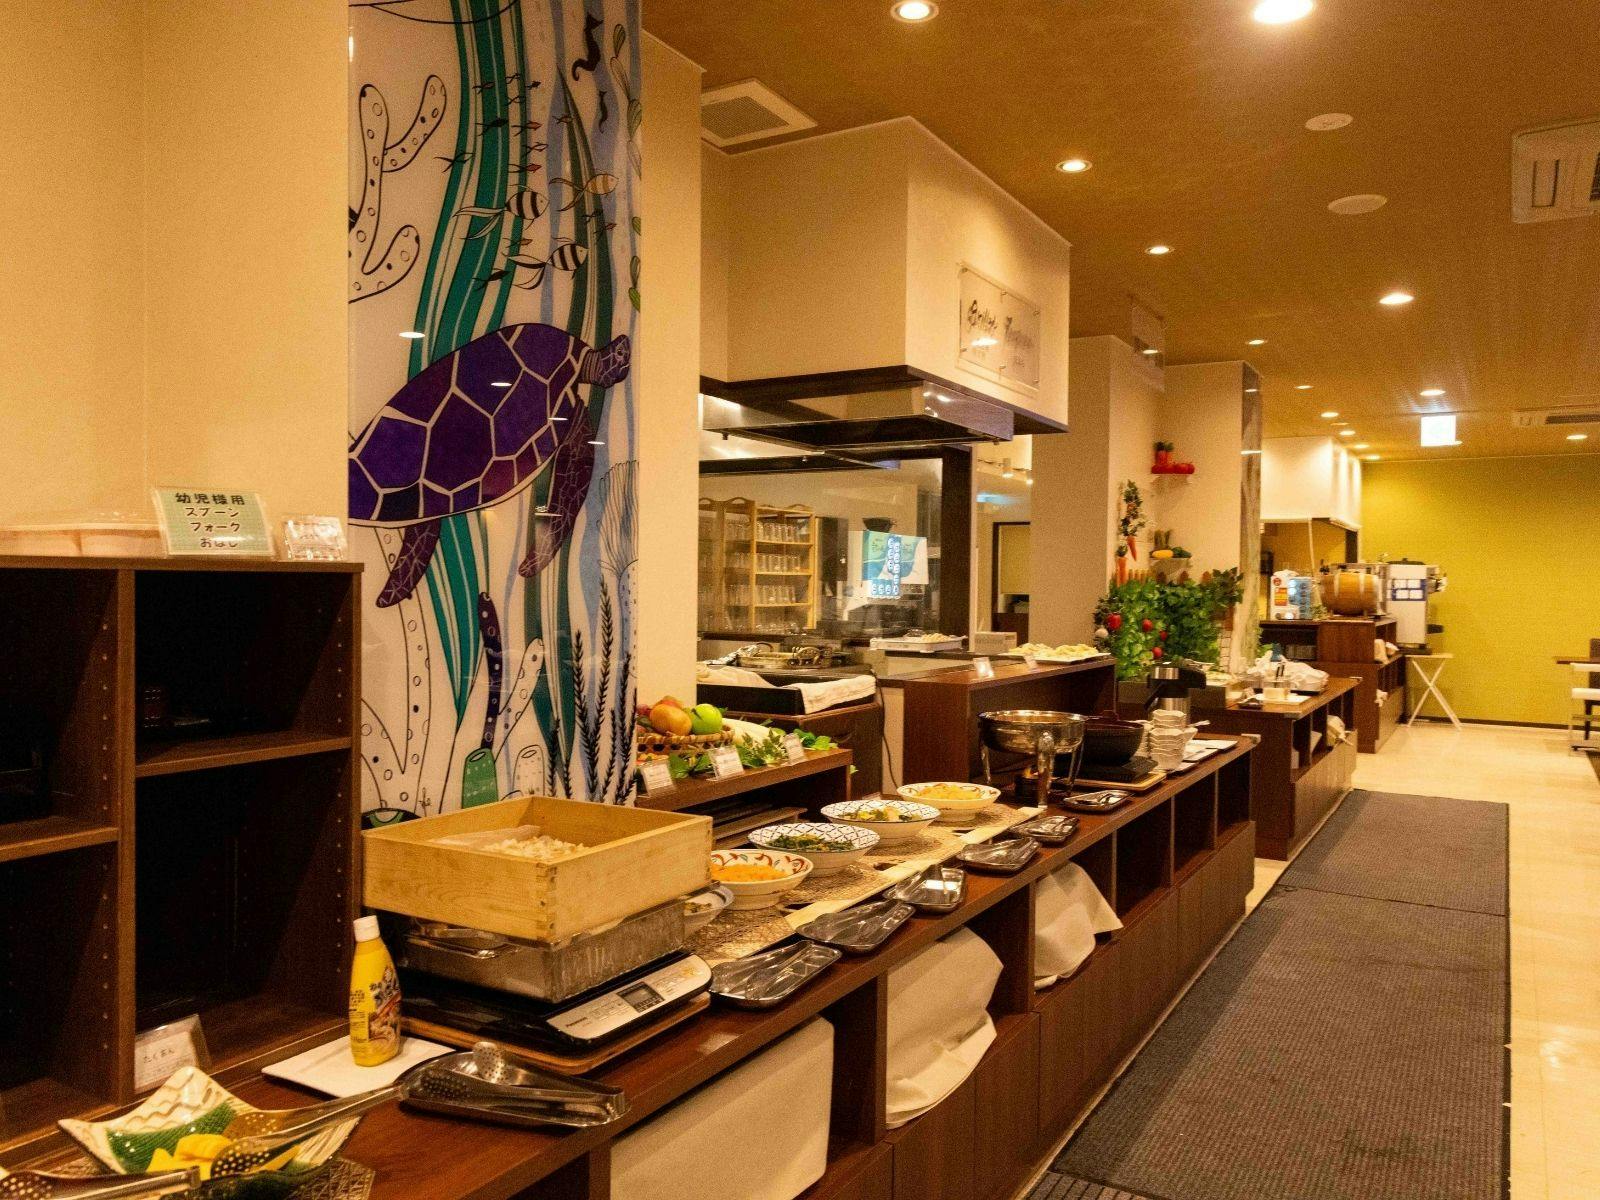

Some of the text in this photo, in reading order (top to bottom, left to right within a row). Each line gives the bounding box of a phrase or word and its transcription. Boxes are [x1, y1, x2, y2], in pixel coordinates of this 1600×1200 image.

[175, 492, 246, 505] 幼児様用
[190, 521, 241, 533] フォーク
